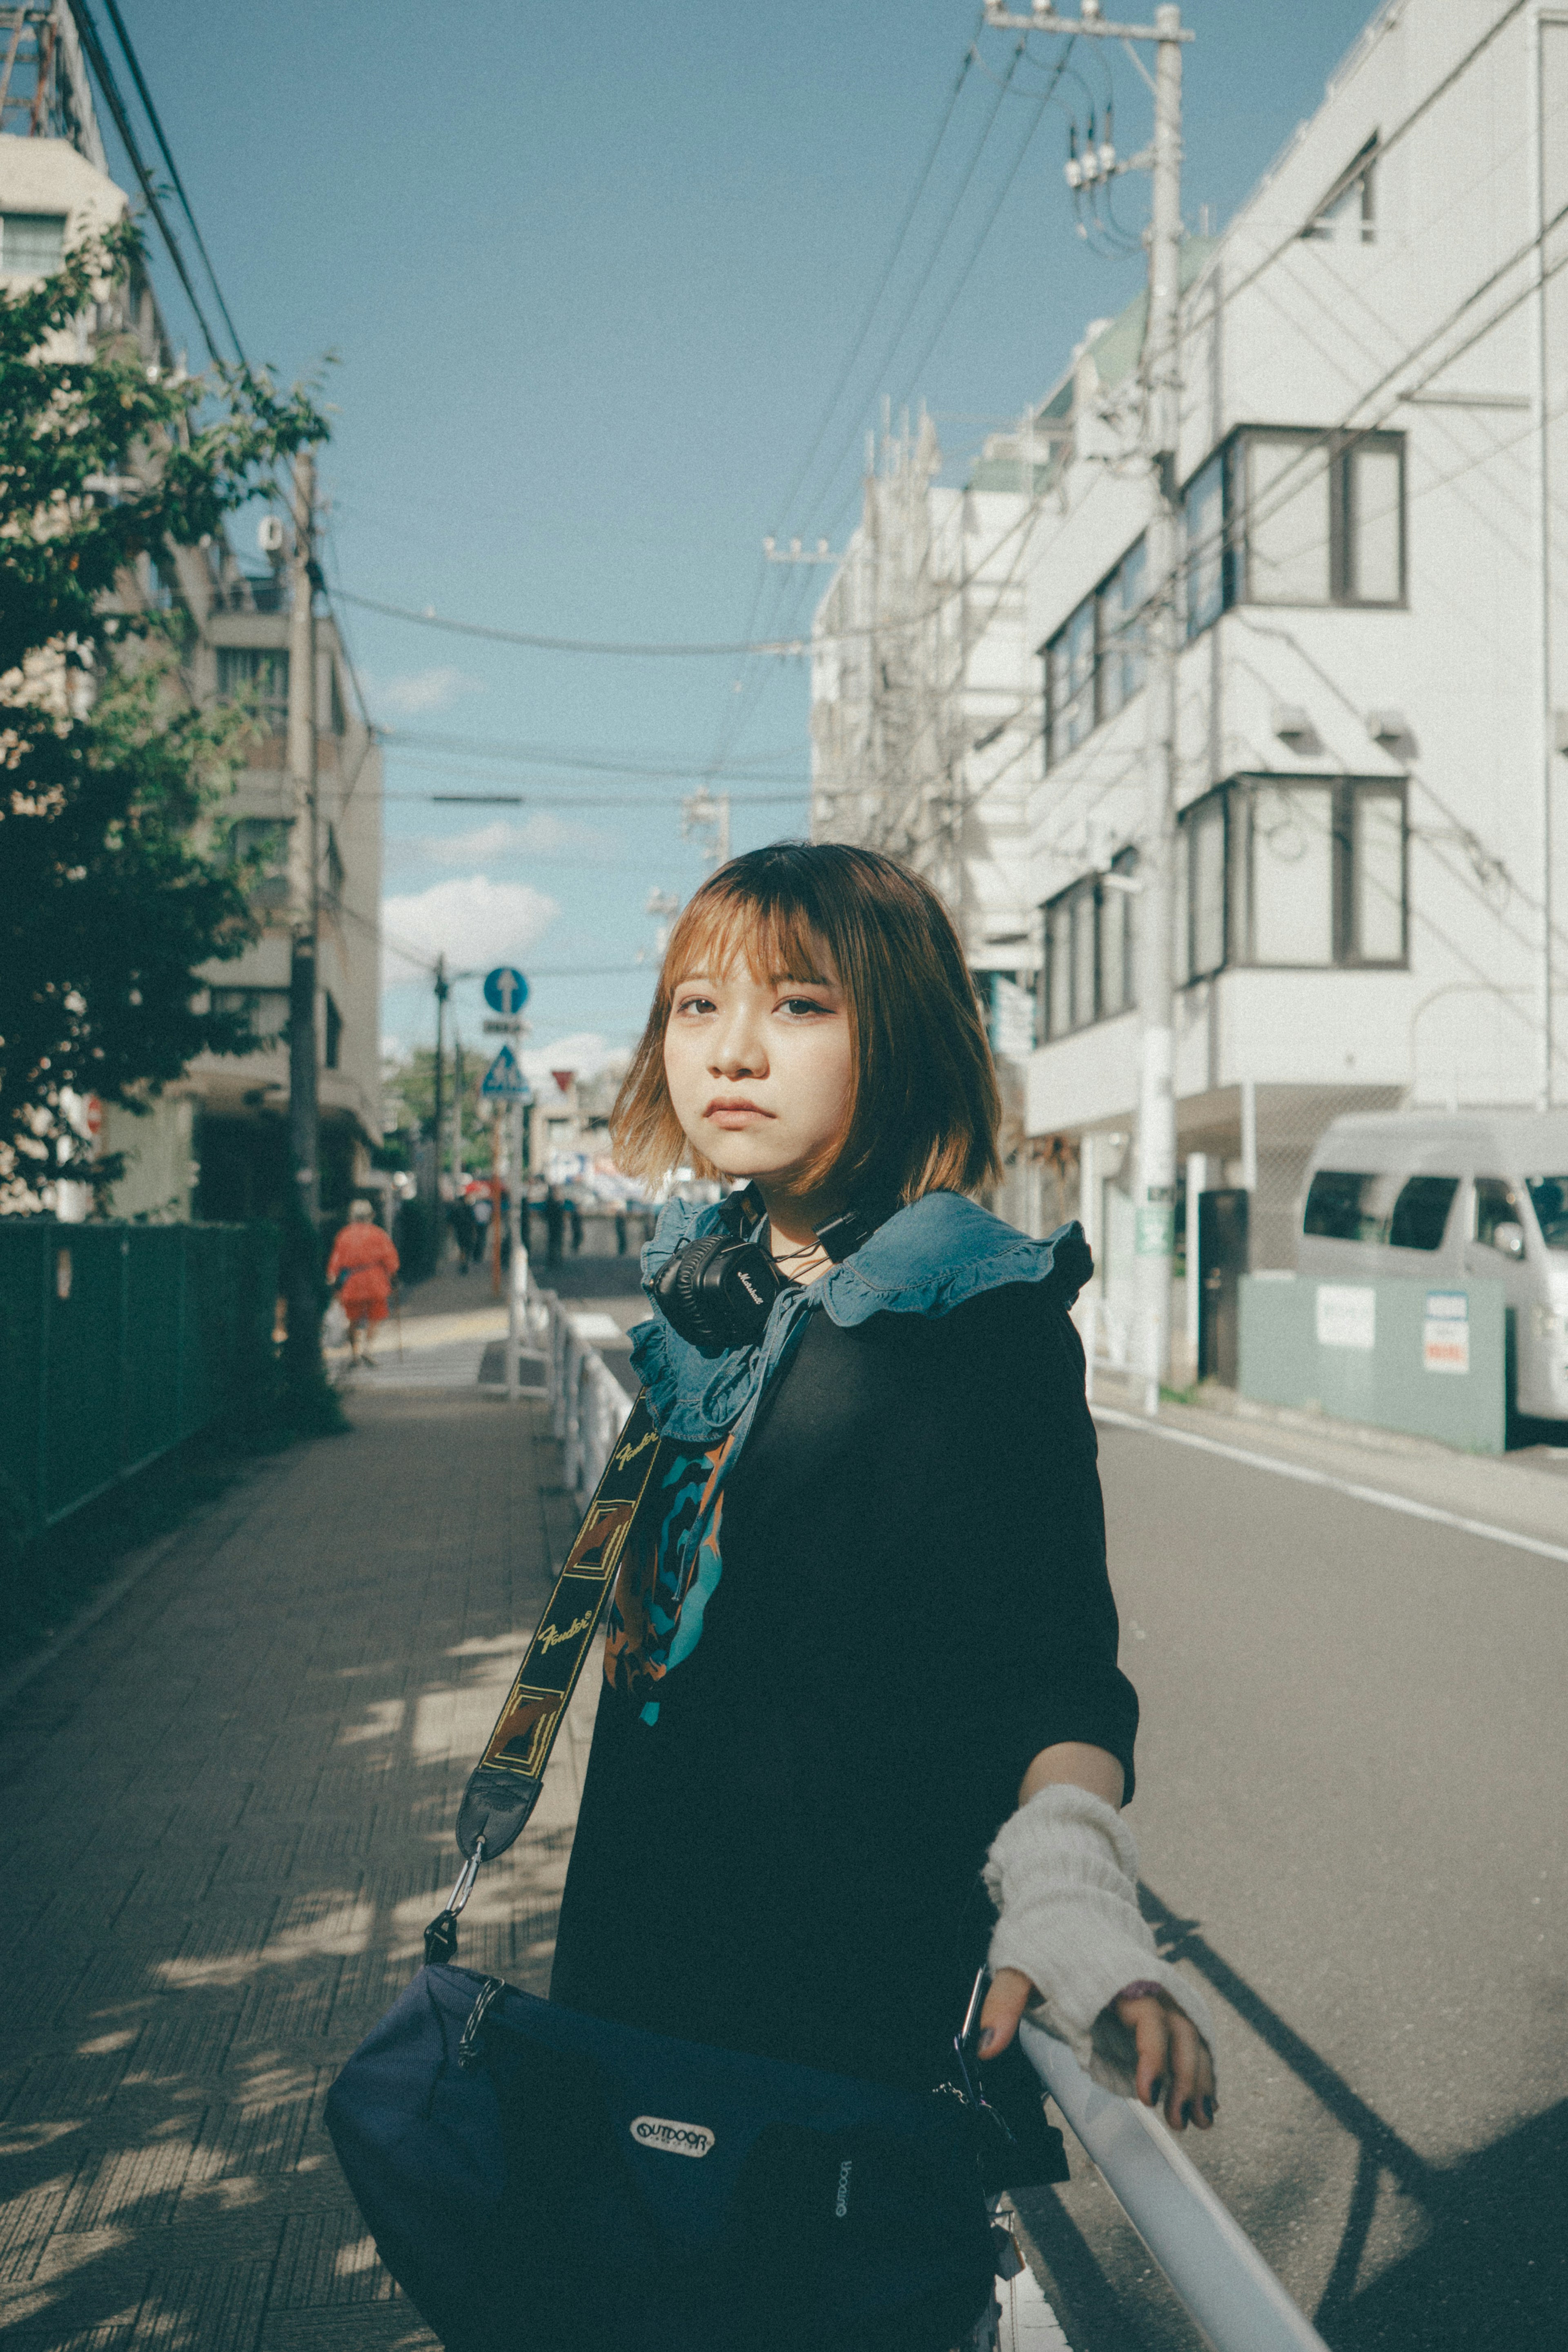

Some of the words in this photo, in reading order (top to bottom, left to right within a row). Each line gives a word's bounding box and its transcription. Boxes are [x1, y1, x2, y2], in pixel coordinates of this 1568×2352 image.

[737, 1271, 764, 1305] Marshall
[615, 1432, 659, 1471] Fender
[538, 1618, 589, 1654] Fender
[637, 2123, 707, 2151] OUTDOOR
[836, 2161, 852, 2217] OUTDOOR
